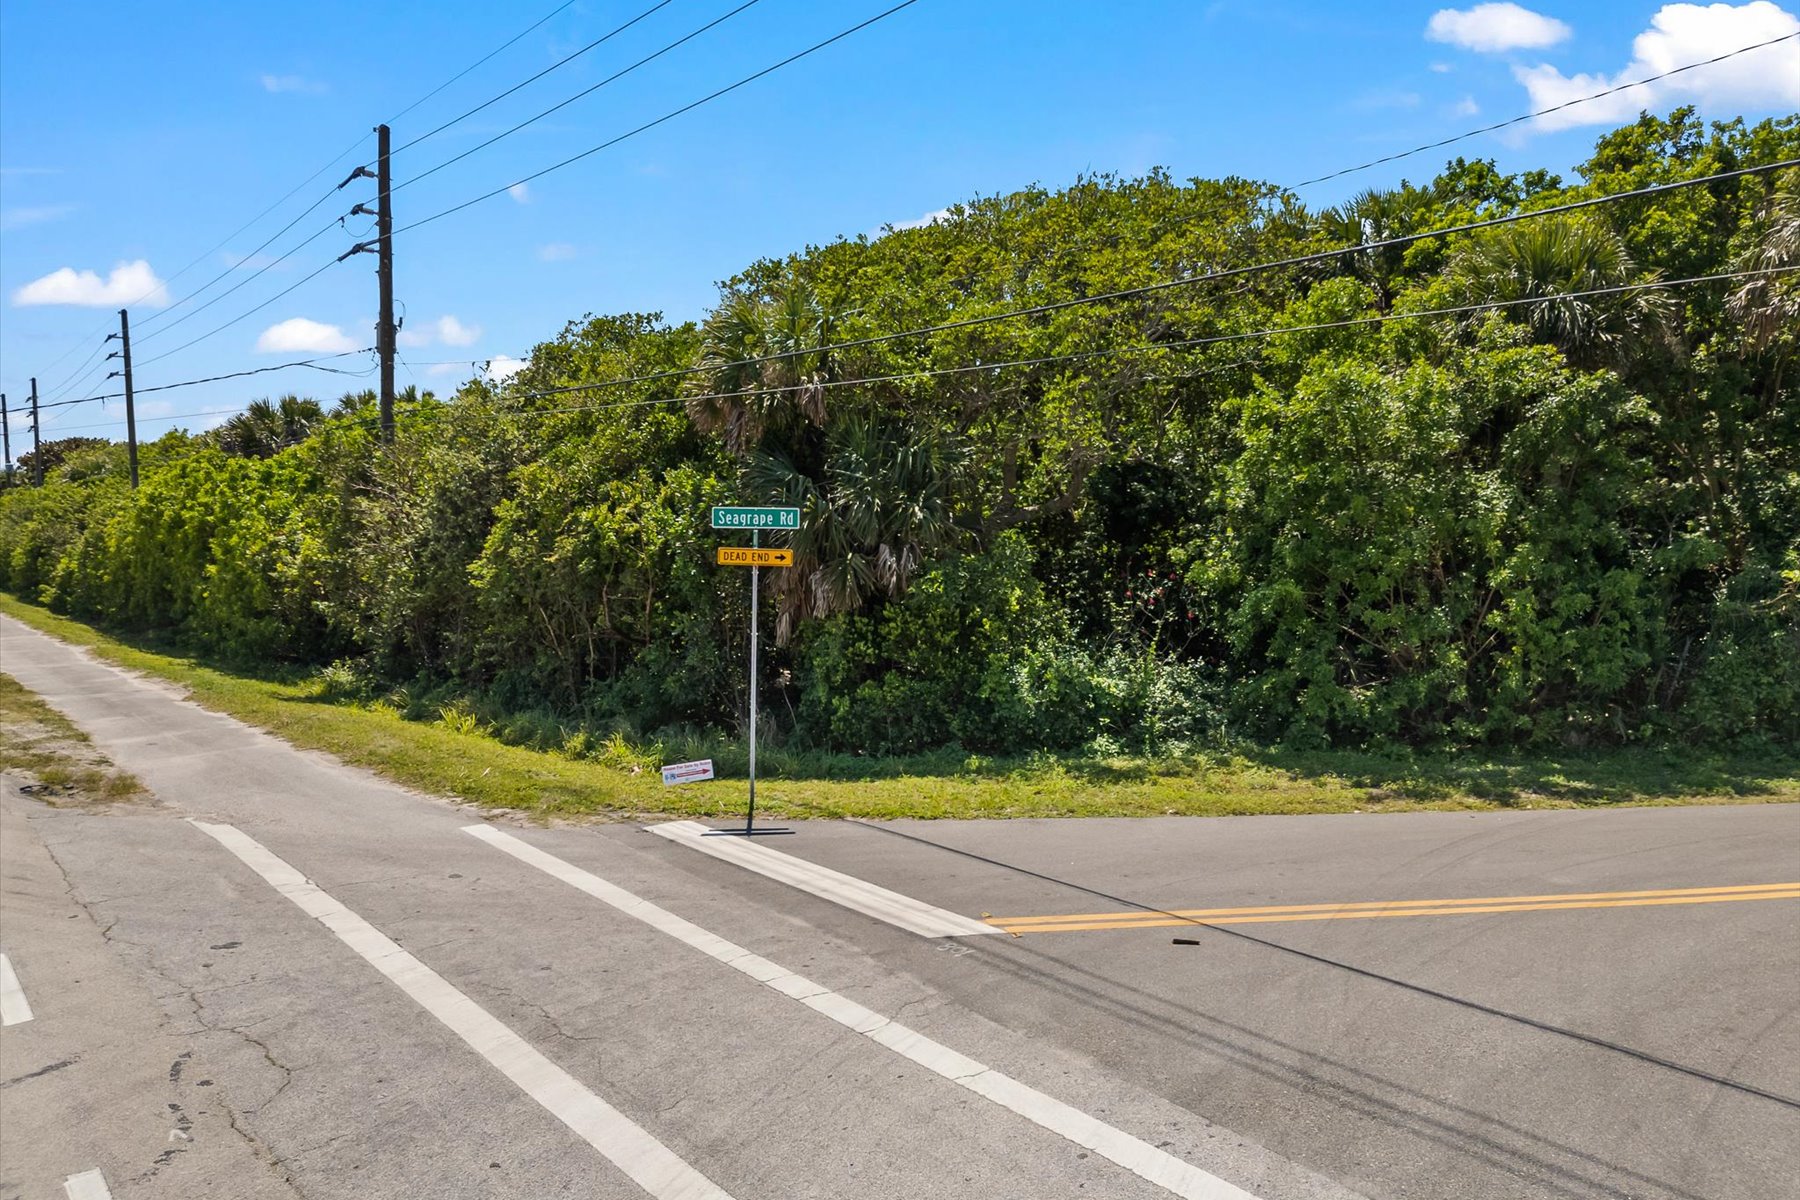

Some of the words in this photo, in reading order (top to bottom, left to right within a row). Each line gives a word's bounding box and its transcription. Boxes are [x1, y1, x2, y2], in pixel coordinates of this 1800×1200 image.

[719, 510, 773, 526] Seagrape
[780, 511, 793, 525] Rd
[723, 551, 747, 561] DEAD
[751, 552, 770, 562] END
